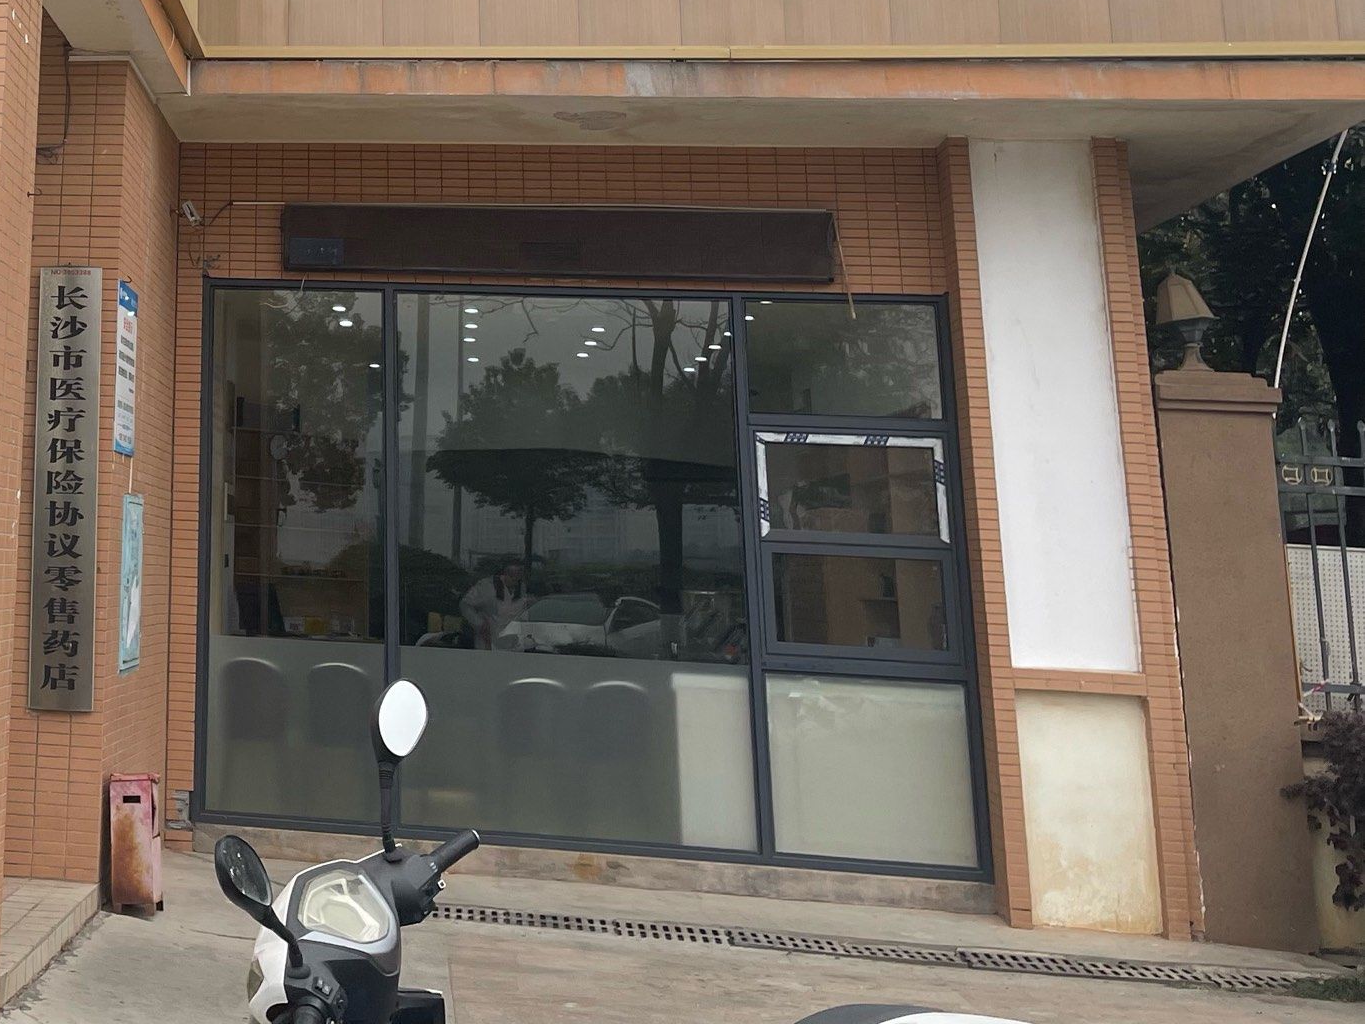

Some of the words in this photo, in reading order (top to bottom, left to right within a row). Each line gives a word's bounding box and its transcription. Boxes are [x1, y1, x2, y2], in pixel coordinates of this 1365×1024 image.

[39, 285, 89, 691] 长沙市医疗保险协议零售药店
